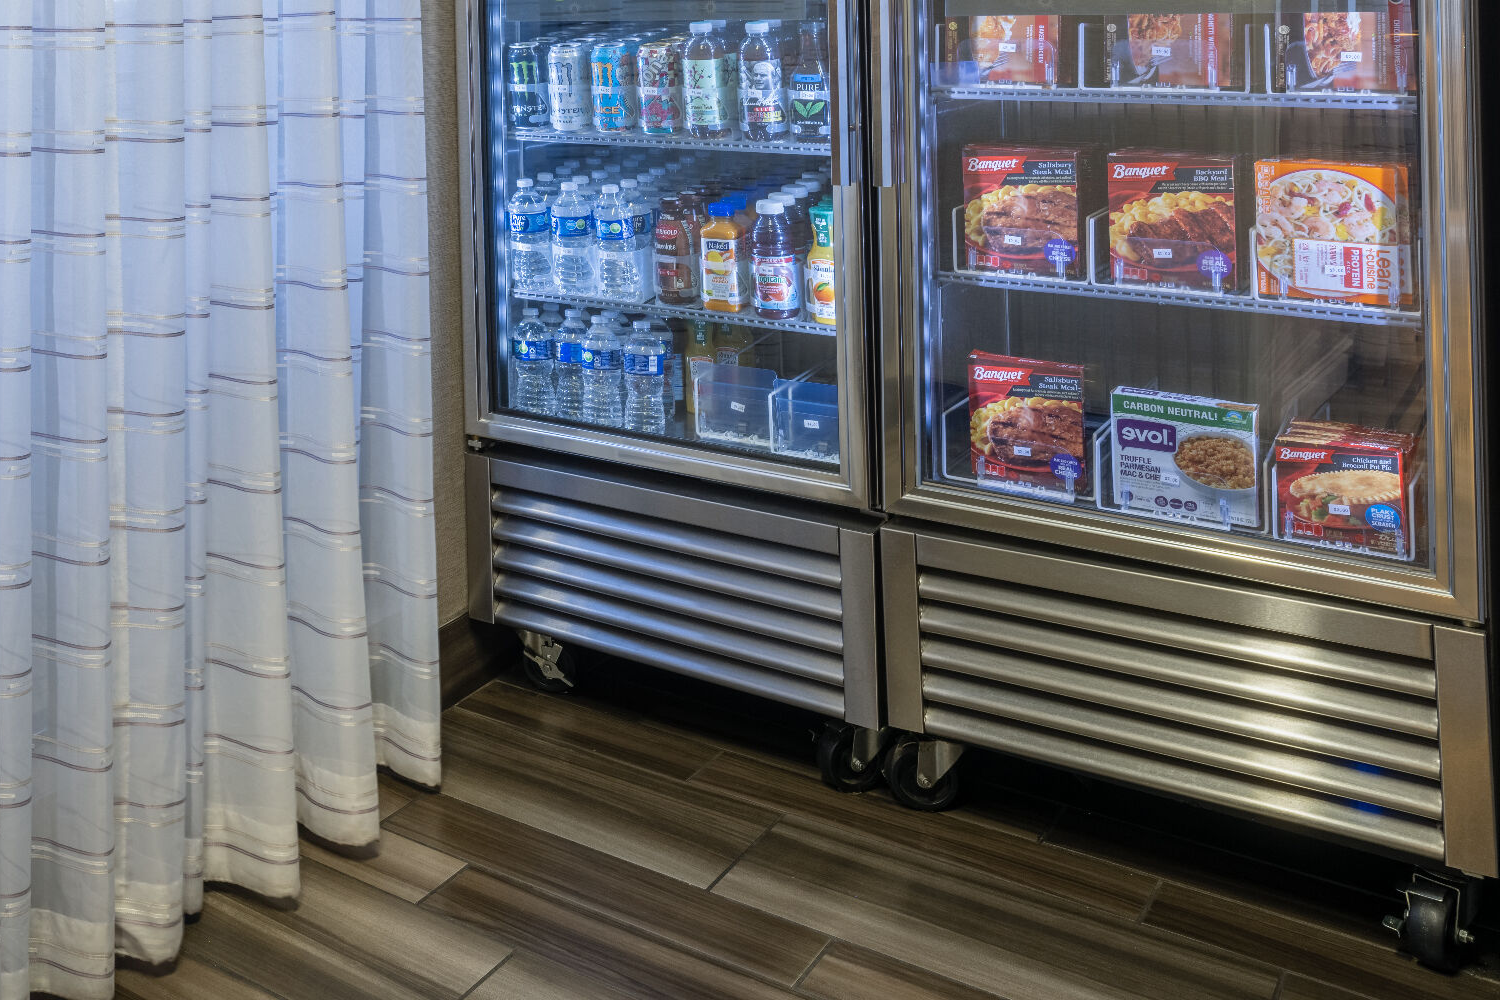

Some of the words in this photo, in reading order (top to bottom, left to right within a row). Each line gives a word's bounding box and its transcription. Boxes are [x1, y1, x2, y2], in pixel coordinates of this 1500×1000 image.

[796, 83, 820, 91] PURE
[968, 158, 1019, 171] Banquet
[1113, 164, 1169, 179] Banquet
[1351, 249, 1361, 287] PROTEIN
[1376, 250, 1391, 289] Lean
[973, 367, 1025, 381] Banquet
[1123, 401, 1164, 414] CARBON
[1167, 406, 1218, 421] NEUTRAL!
[1120, 454, 1152, 464] TRUFFLE
[1280, 448, 1328, 460] Banquet
[1120, 461, 1161, 473] PARMESAN
[1120, 469, 1137, 477] MAC
